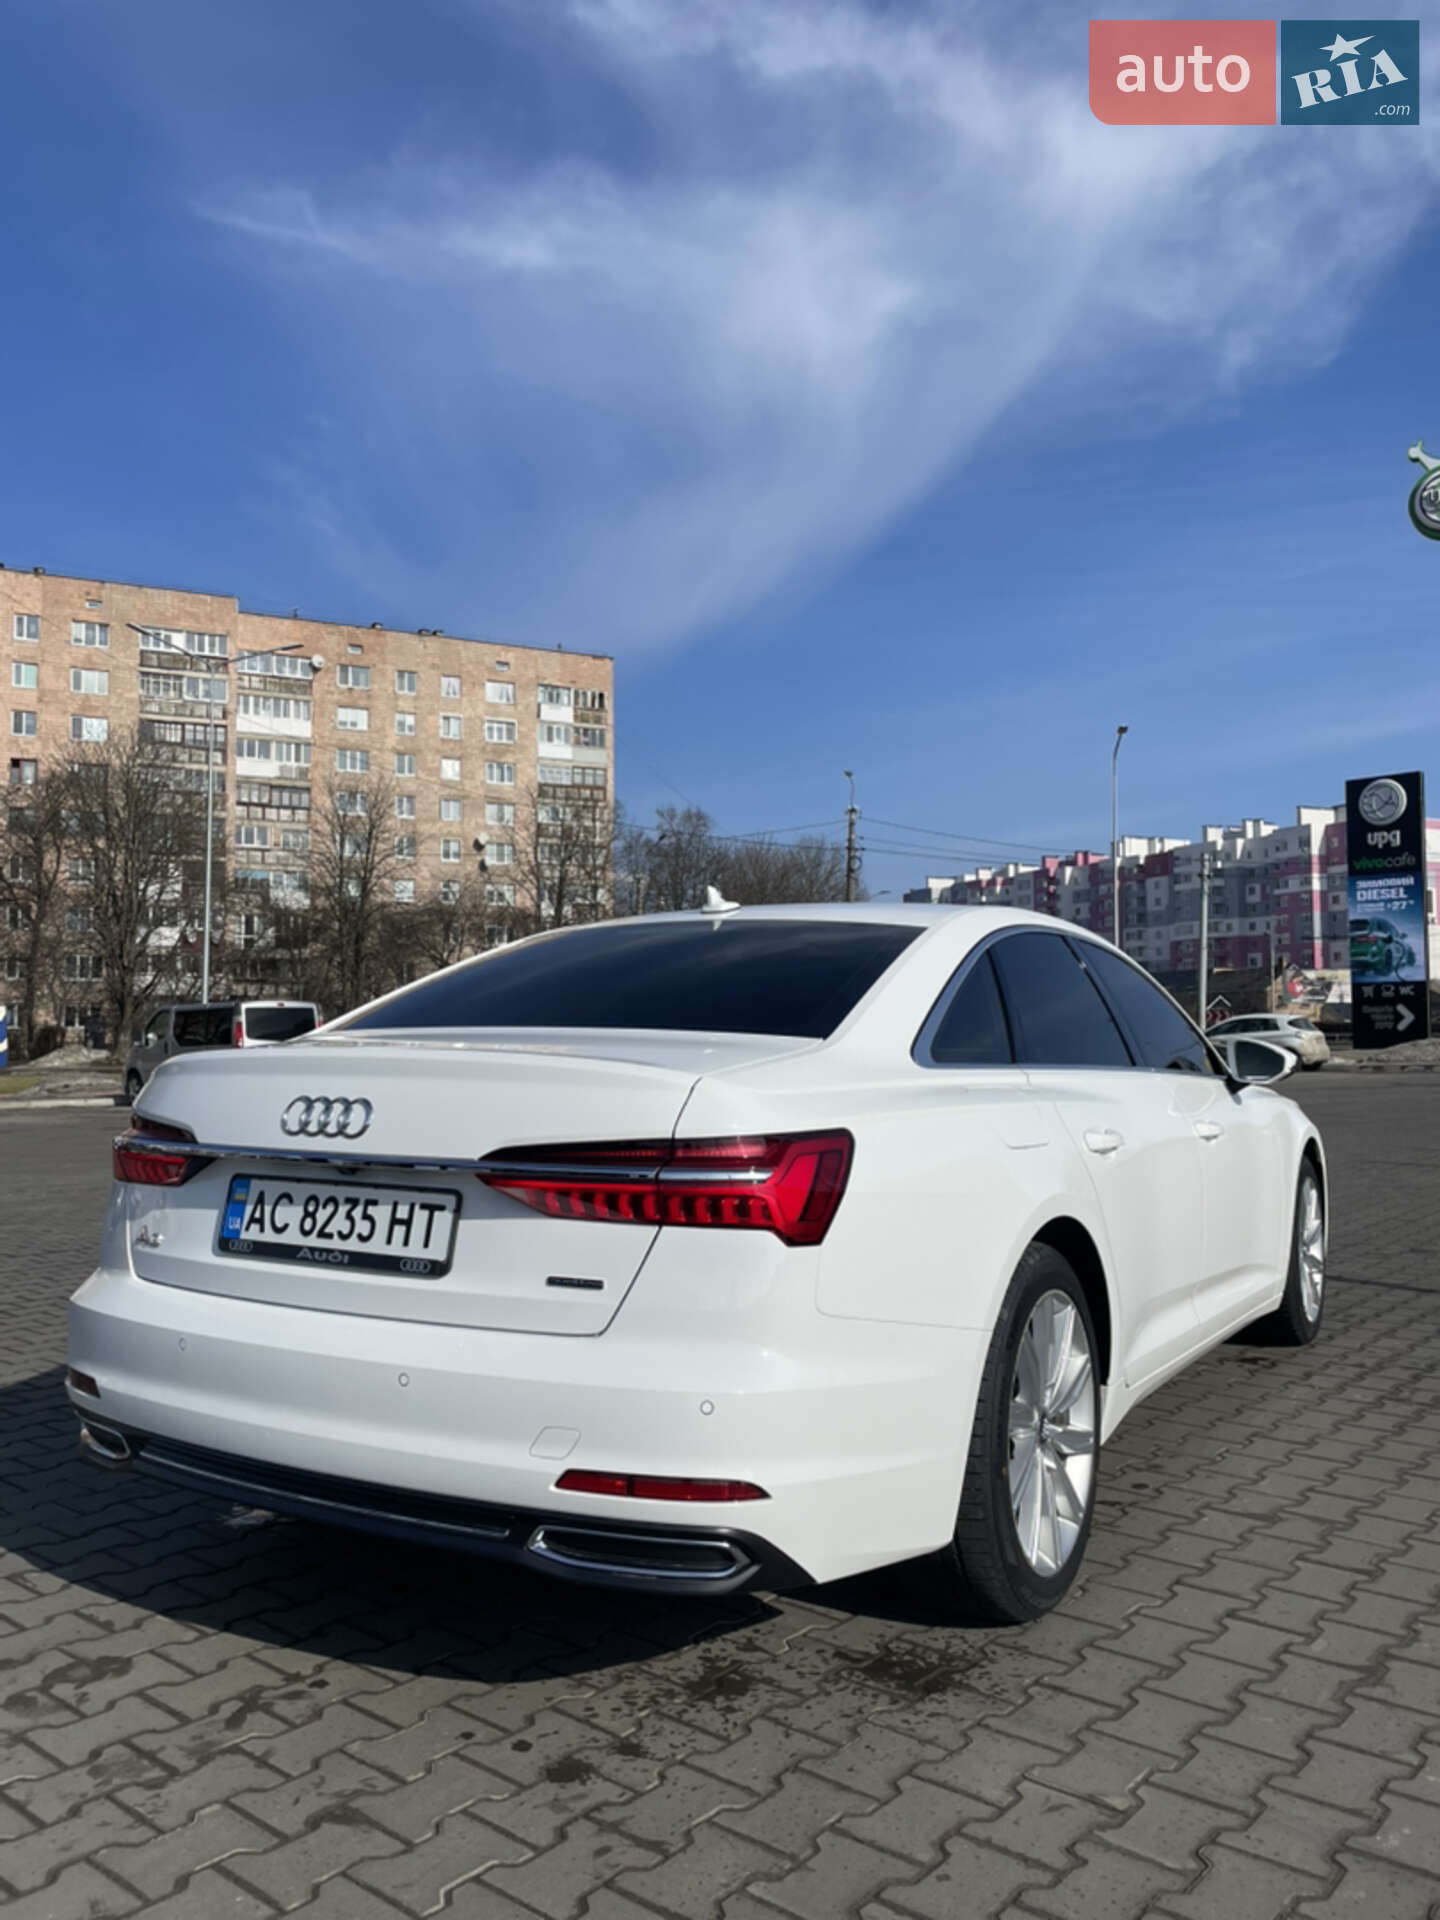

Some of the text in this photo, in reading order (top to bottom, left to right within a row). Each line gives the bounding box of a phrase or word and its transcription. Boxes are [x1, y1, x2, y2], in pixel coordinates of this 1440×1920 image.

[1367, 830, 1401, 849] upg
[1356, 887, 1408, 902] DIESEL
[228, 1216, 241, 1230] UA
[245, 1190, 447, 1249] AC 8235 HT
